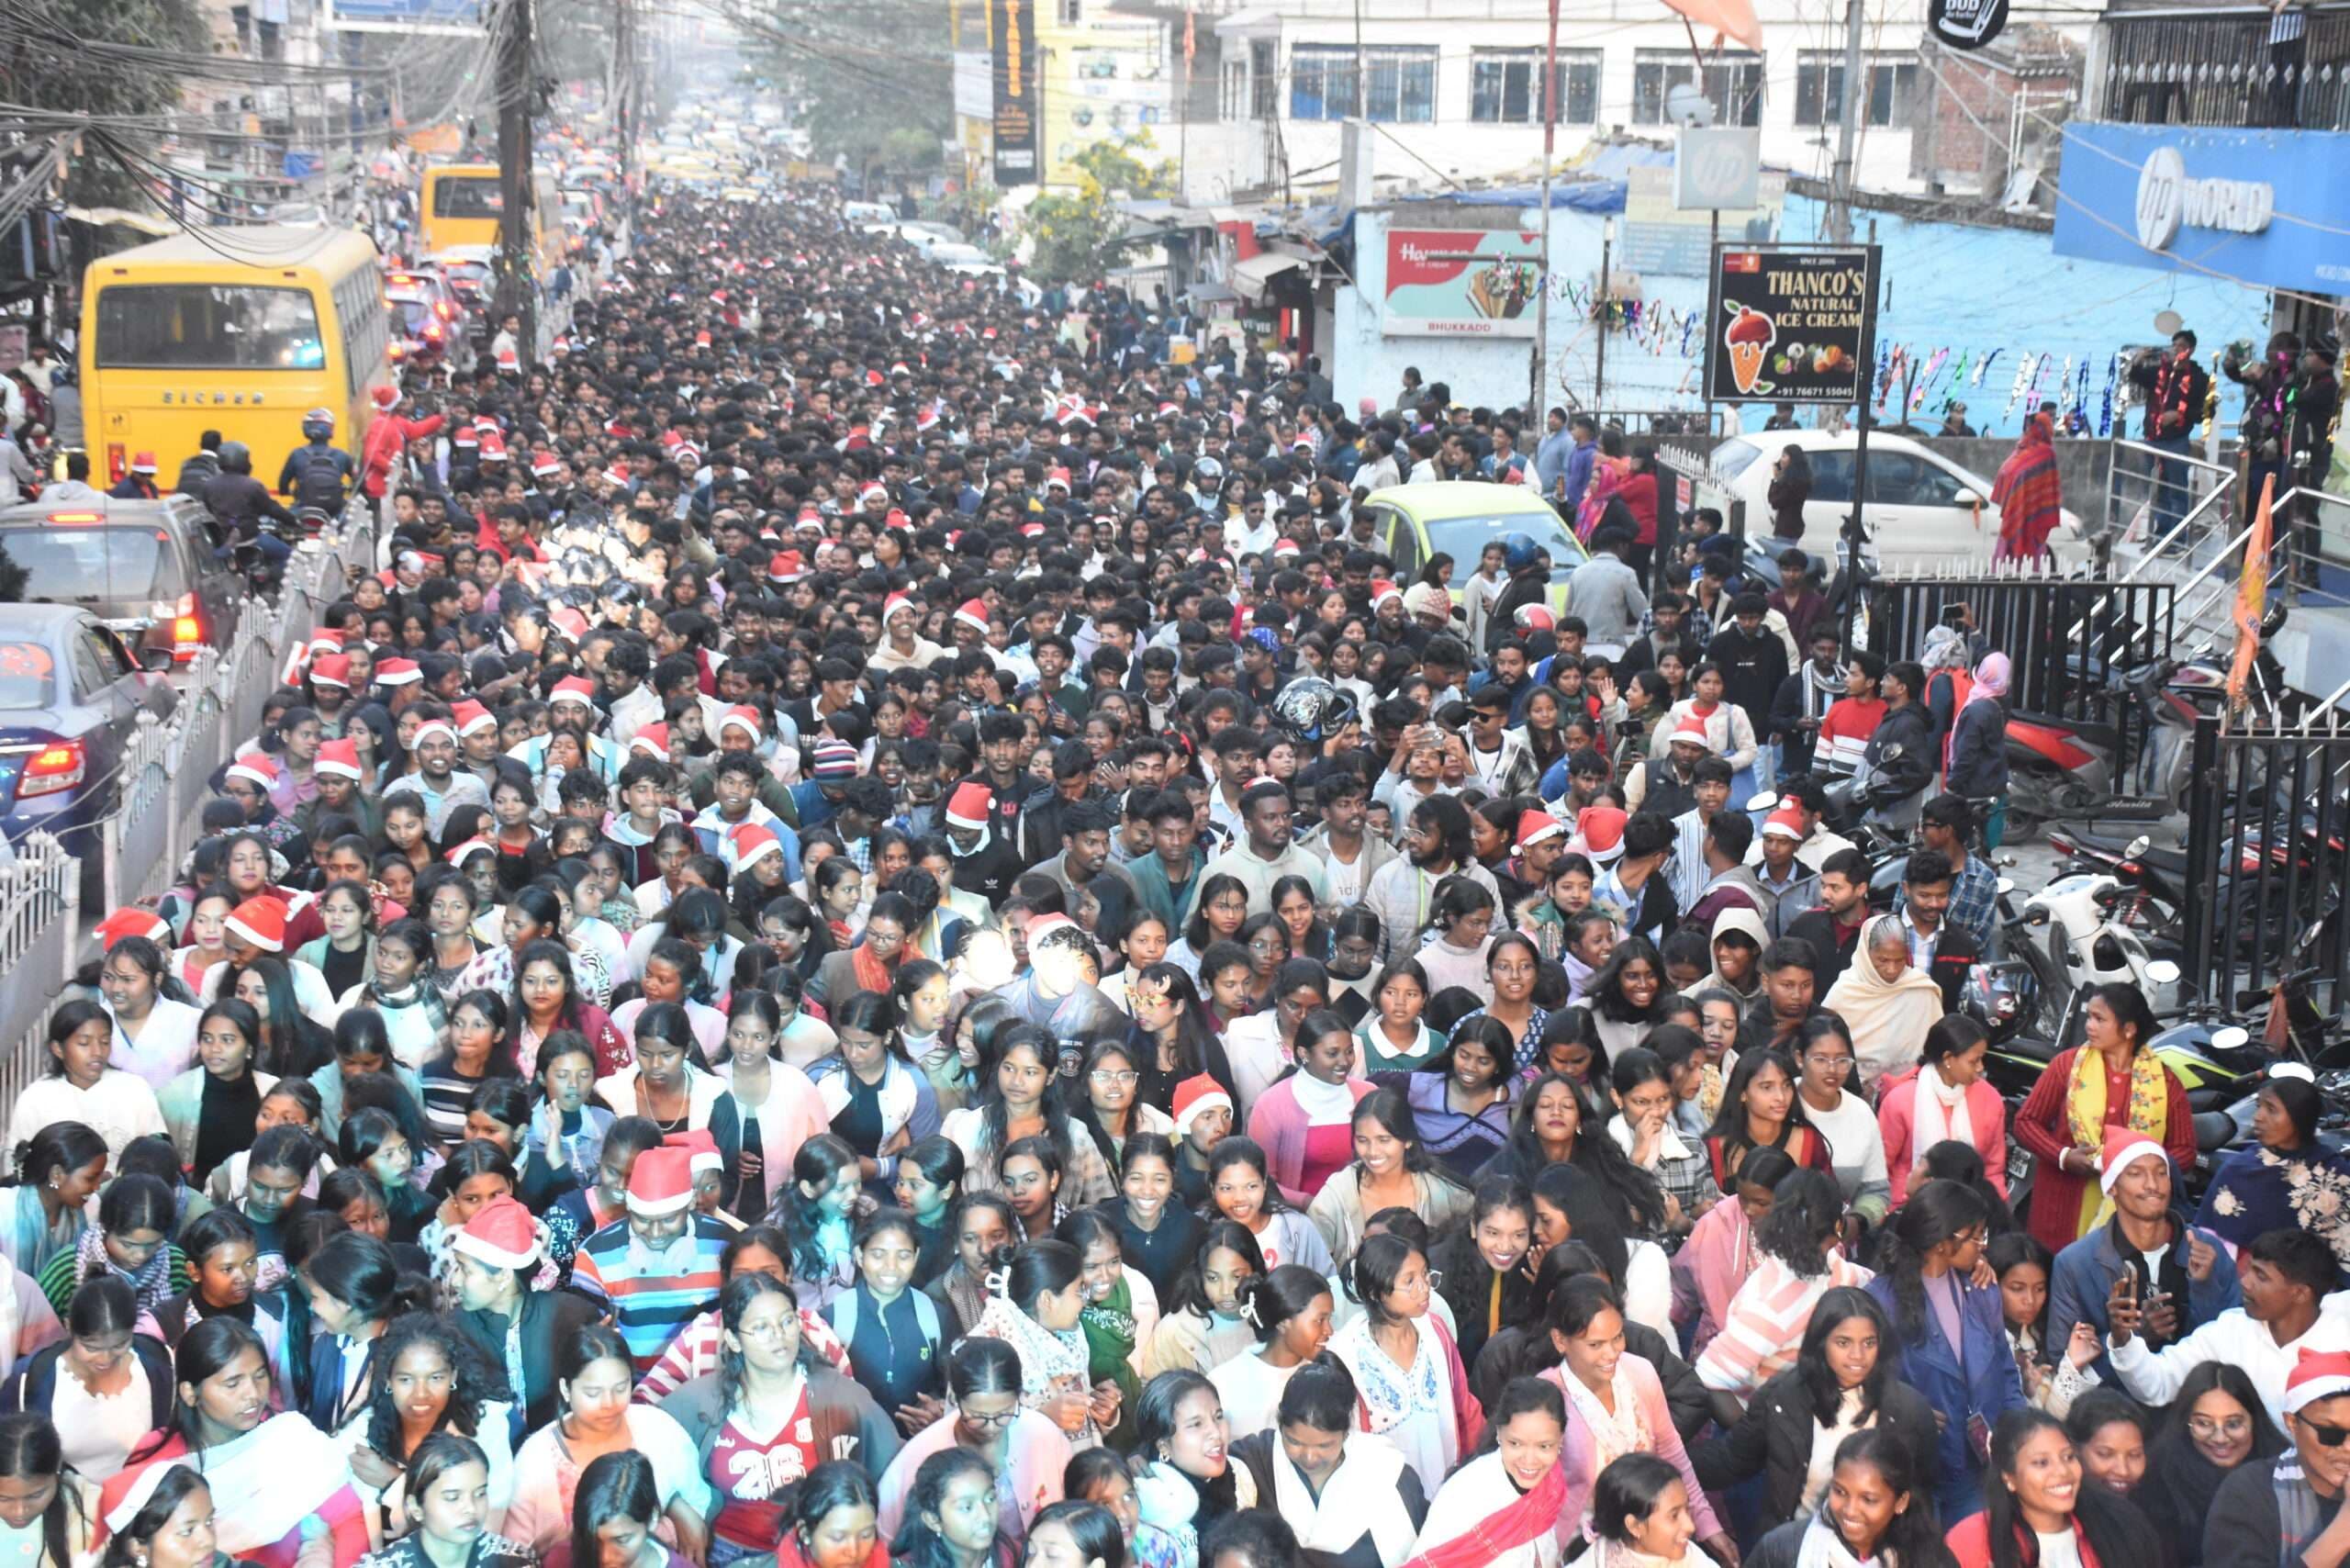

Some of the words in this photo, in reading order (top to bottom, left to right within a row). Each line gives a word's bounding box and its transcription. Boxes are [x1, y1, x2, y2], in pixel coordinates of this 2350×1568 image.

[2183, 177, 2273, 232] WORLD
[1766, 267, 1863, 296] THANCO'S
[1791, 297, 1856, 311] NATURAL
[1427, 322, 1492, 332] BHUKKADD
[1775, 313, 1801, 327] ICE
[1806, 313, 1861, 327] CREAM
[162, 390, 264, 405] EICHER
[1776, 387, 1793, 396] +91
[1796, 386, 1823, 396] 76671
[1825, 386, 1852, 396] 55045
